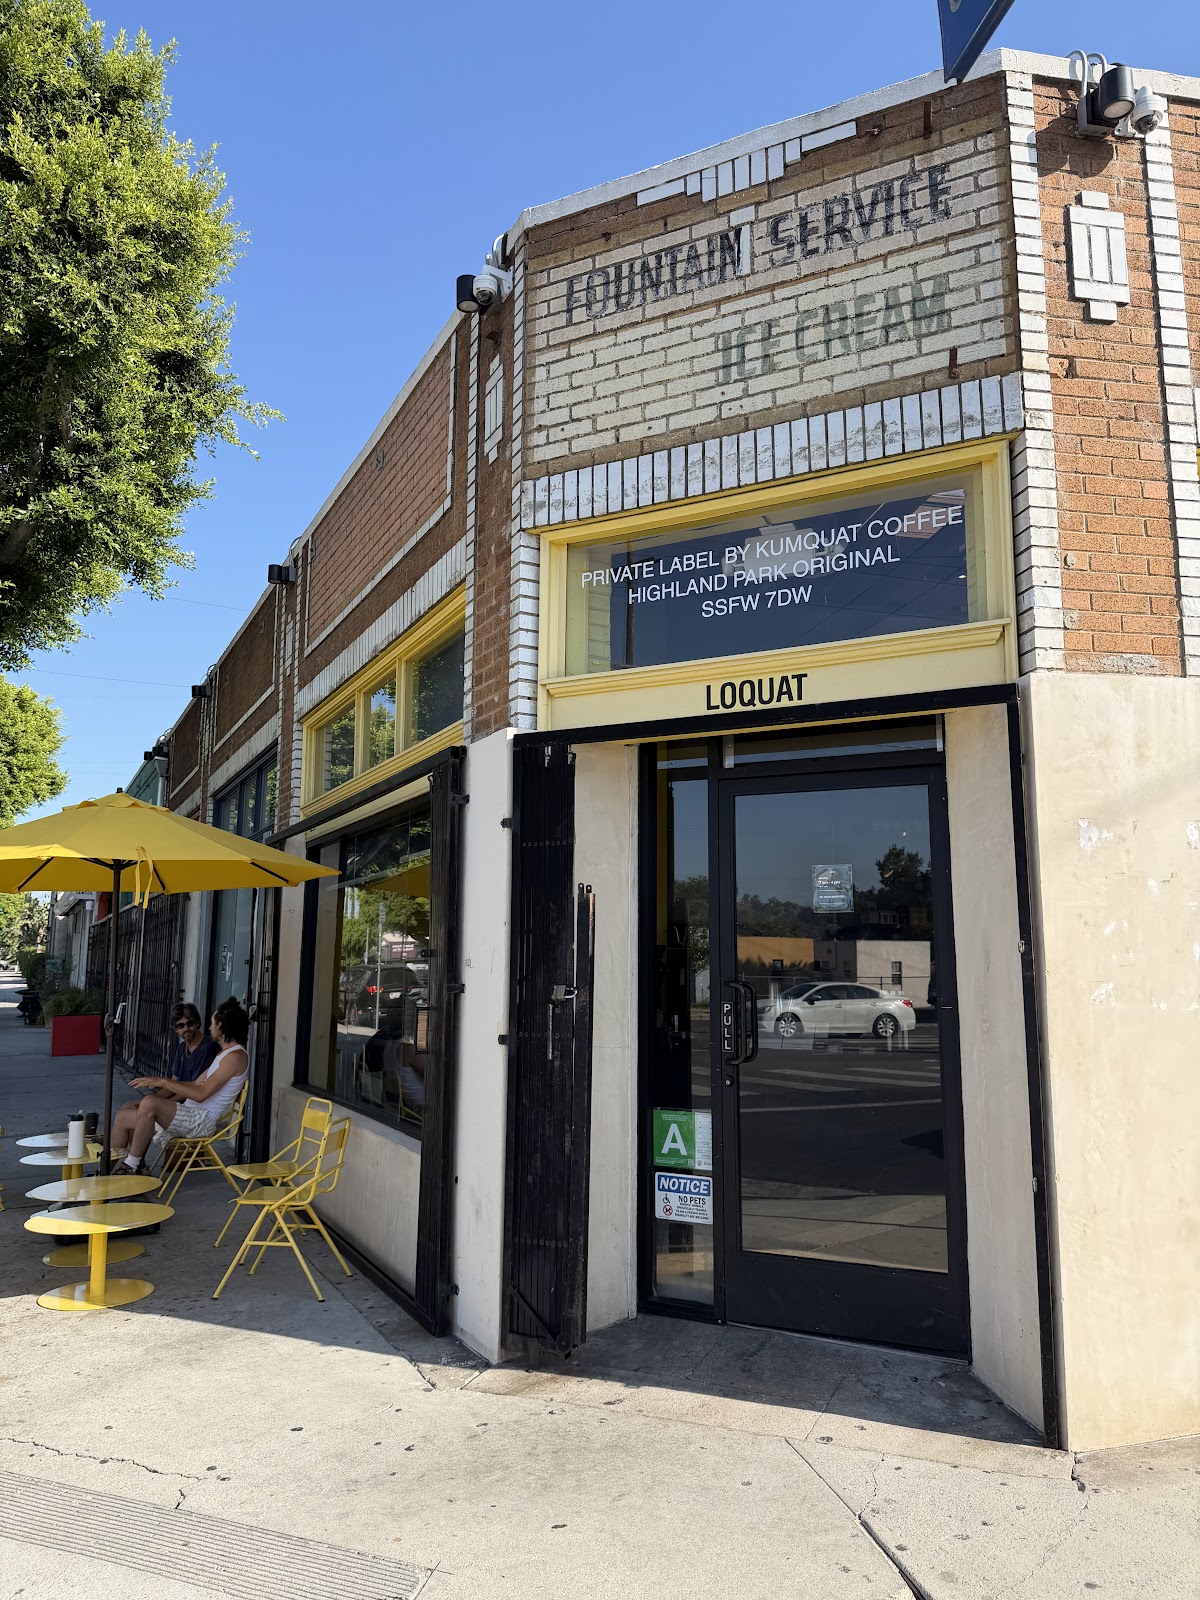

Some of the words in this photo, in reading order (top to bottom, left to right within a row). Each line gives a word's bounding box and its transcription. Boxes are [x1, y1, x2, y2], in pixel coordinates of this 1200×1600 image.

[566, 227, 743, 326] FOUNTAIN
[771, 165, 951, 265] SERVICE
[721, 319, 781, 383] ICE
[796, 276, 946, 363] CREAM
[581, 560, 655, 588] PRIVATE
[659, 552, 720, 576] LABEL
[725, 543, 751, 564] BY
[755, 524, 862, 559] KUMQUAT
[867, 505, 963, 539] COFFEE
[628, 576, 728, 605] HIGHLAND
[733, 564, 788, 588] PARK
[792, 544, 900, 579] ORIGINAL
[701, 594, 760, 618] SSFW
[765, 584, 813, 608] 7DW
[706, 673, 808, 711] LOQUAT
[723, 1003, 731, 1050] PULL
[661, 1123, 688, 1156] A
[659, 1177, 709, 1194] NOTICE
[678, 1195, 688, 1203] NO
[689, 1197, 706, 1206] PETS
